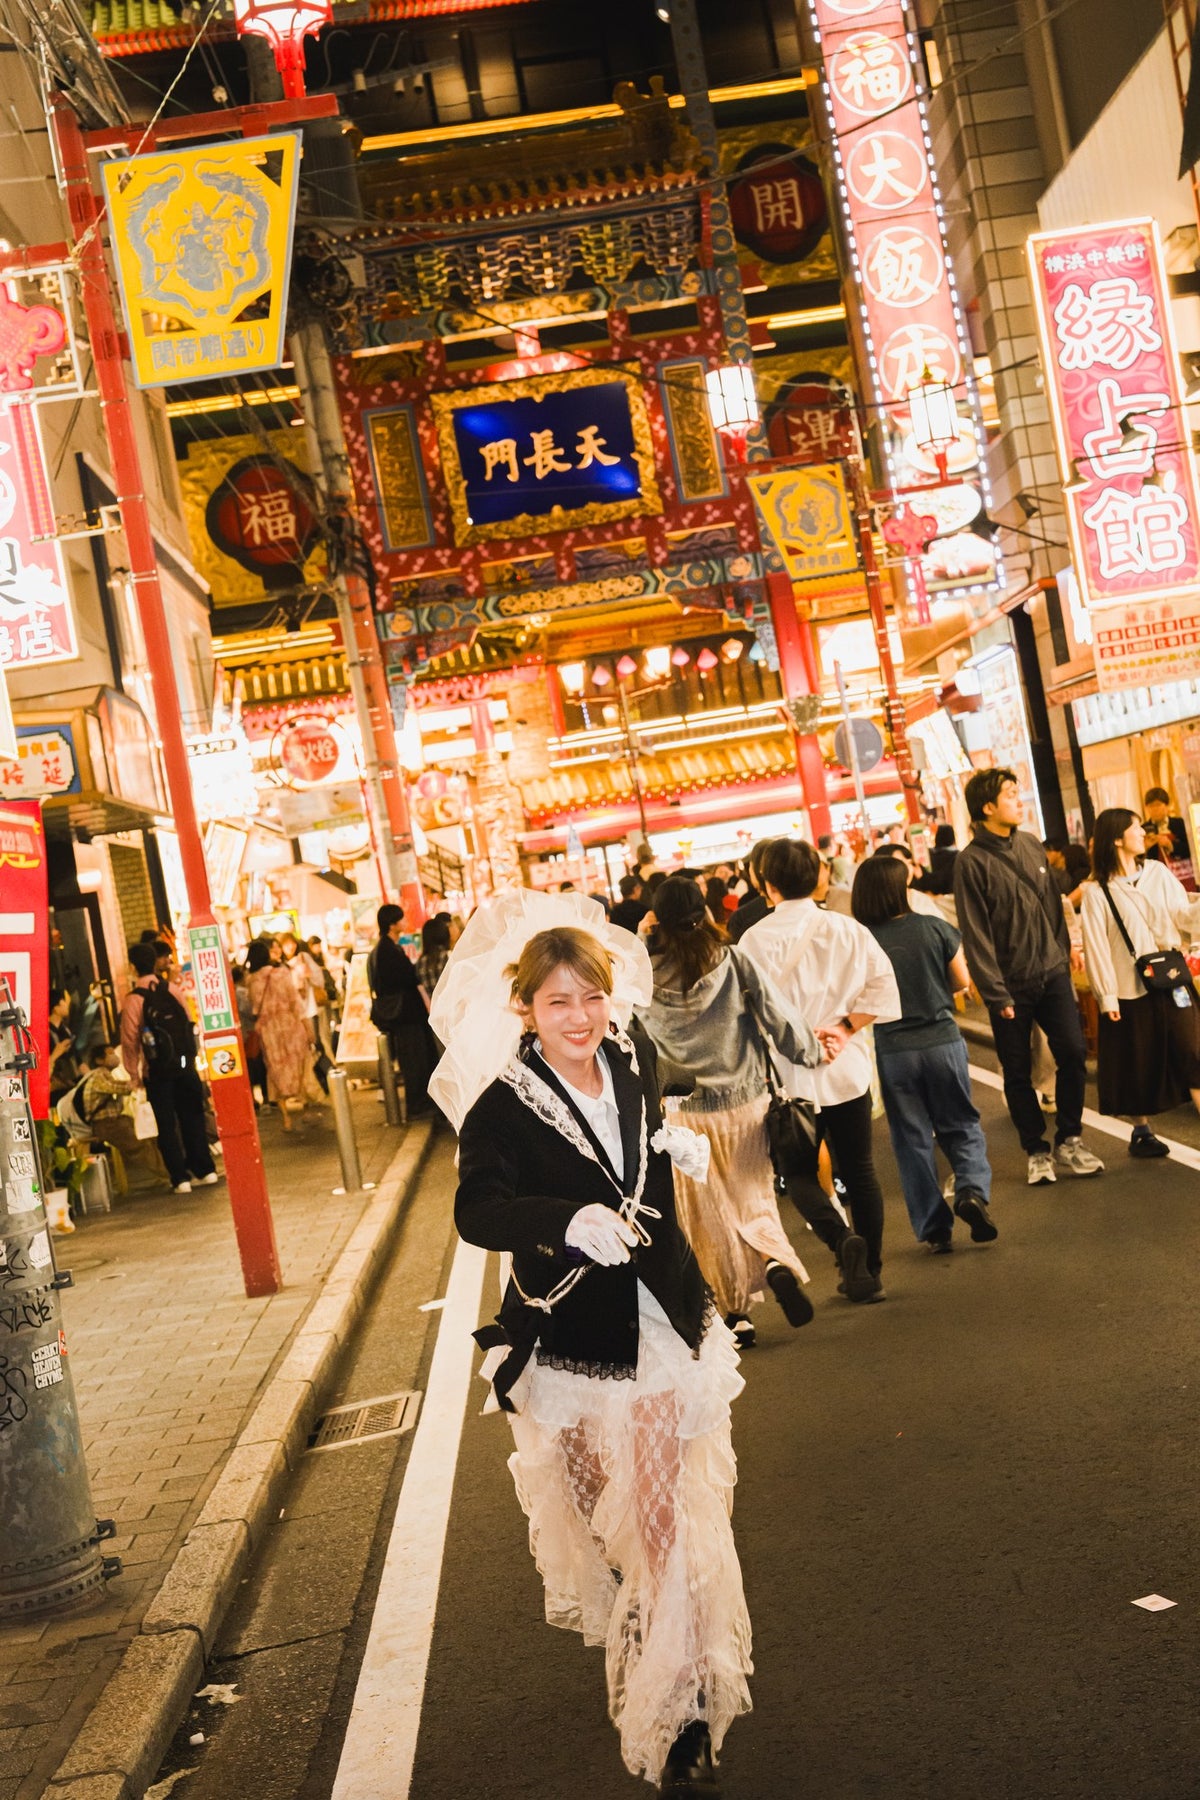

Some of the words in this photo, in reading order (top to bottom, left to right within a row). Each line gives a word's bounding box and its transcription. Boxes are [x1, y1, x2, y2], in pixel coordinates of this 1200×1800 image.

[750, 179, 804, 233] 開
[1053, 277, 1189, 580] 縁占館
[241, 490, 296, 545] 福
[197, 950, 225, 1010] 関帝廟
